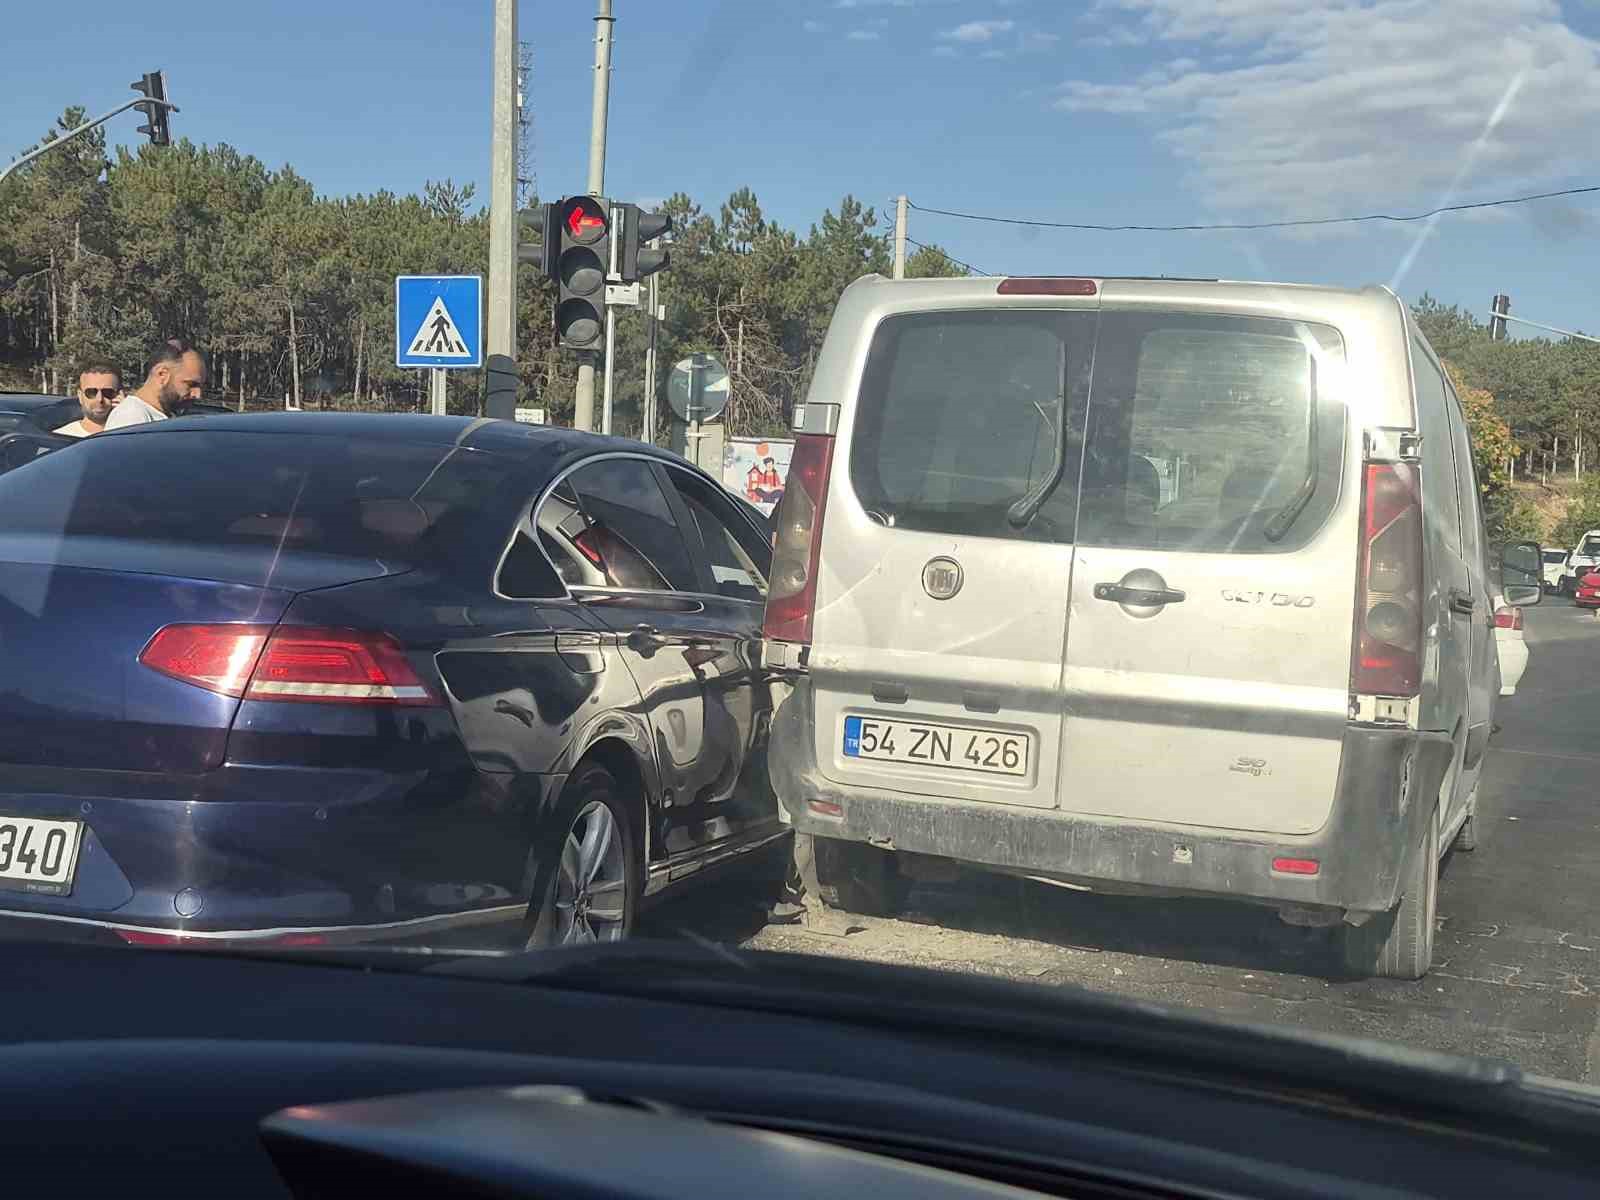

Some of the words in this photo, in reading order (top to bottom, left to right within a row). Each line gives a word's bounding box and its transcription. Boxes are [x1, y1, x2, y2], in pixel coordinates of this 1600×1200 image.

[861, 723, 896, 756] 54
[907, 728, 952, 762] ZN
[964, 734, 1020, 769] 426
[0, 824, 67, 876] 340
